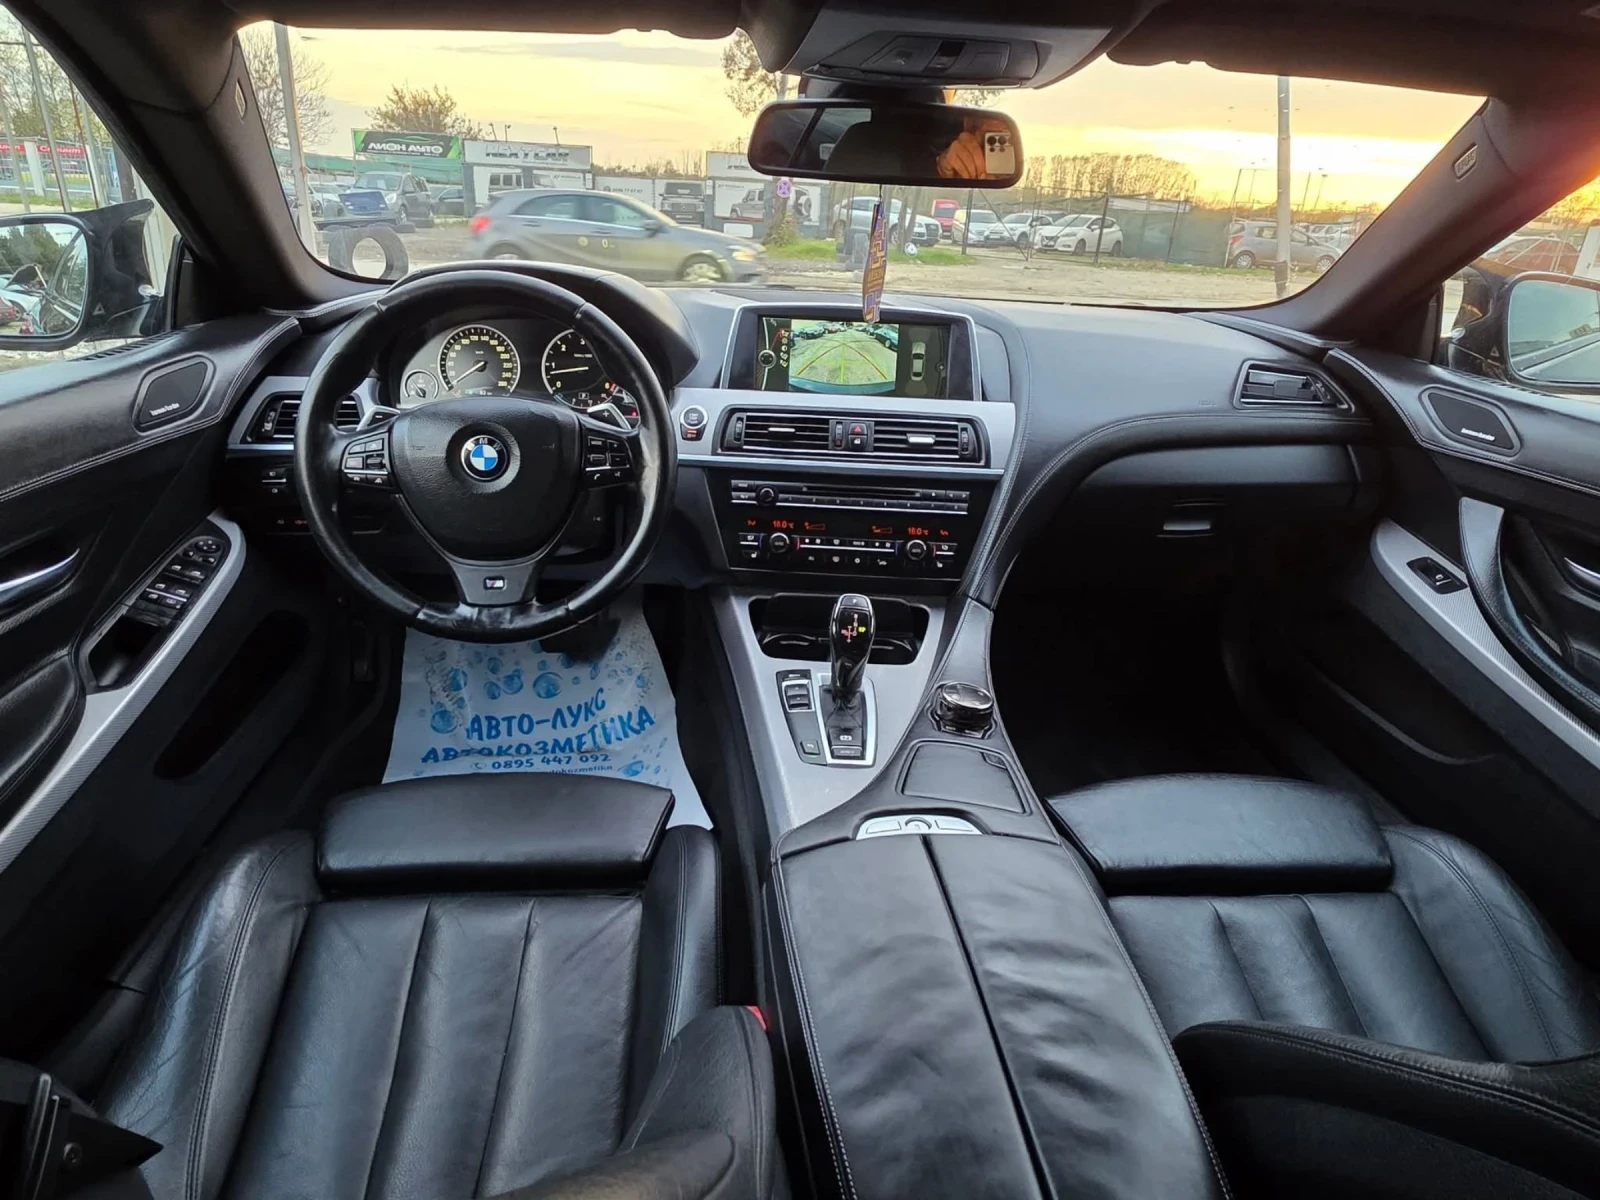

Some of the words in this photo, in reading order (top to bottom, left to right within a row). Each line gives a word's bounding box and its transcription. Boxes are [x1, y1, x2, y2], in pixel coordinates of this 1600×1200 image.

[466, 687, 606, 741] АВТО-ЛУКС
[491, 757, 534, 770] 0895
[540, 755, 573, 766] 447
[579, 753, 612, 764] 092
